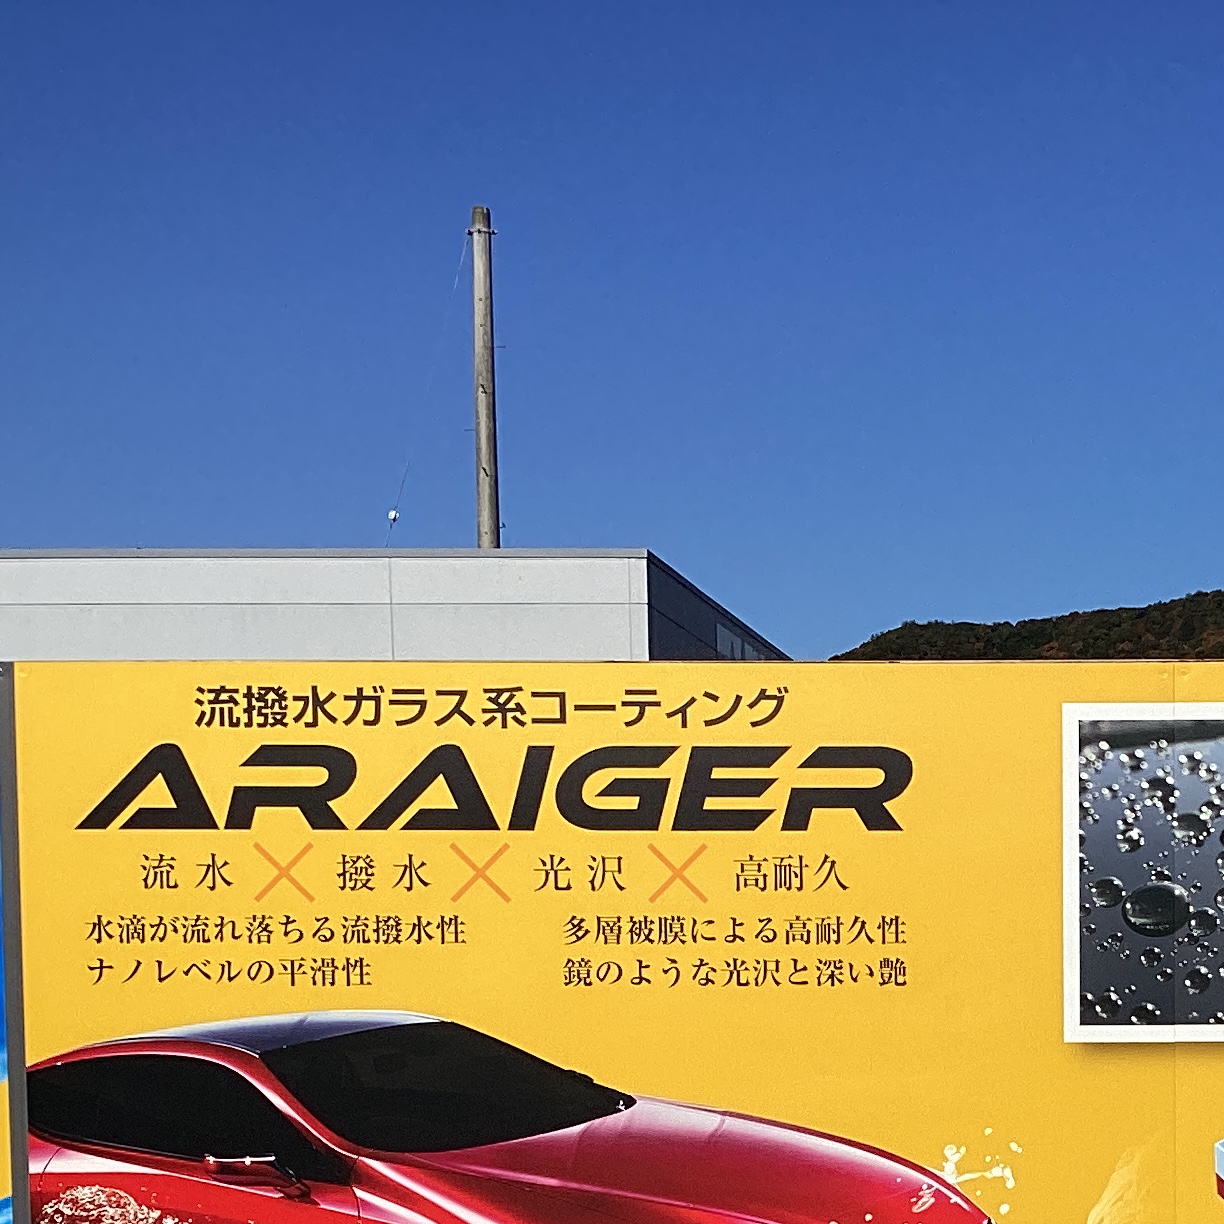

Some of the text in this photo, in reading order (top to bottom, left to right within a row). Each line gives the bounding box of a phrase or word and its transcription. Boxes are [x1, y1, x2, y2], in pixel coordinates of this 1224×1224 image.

[193, 684, 790, 730] 流撥水ガラス系コーティング
[75, 742, 914, 832] ARAIGER
[733, 853, 851, 893] 高耐久
[84, 913, 467, 945] 水滴が流れ落ちる流撥水性
[562, 914, 907, 946] 多層被膜による高耐久性
[86, 956, 373, 988] ナノレベルの平滑性
[562, 956, 908, 989] 鏡のような光沢と深い艶
